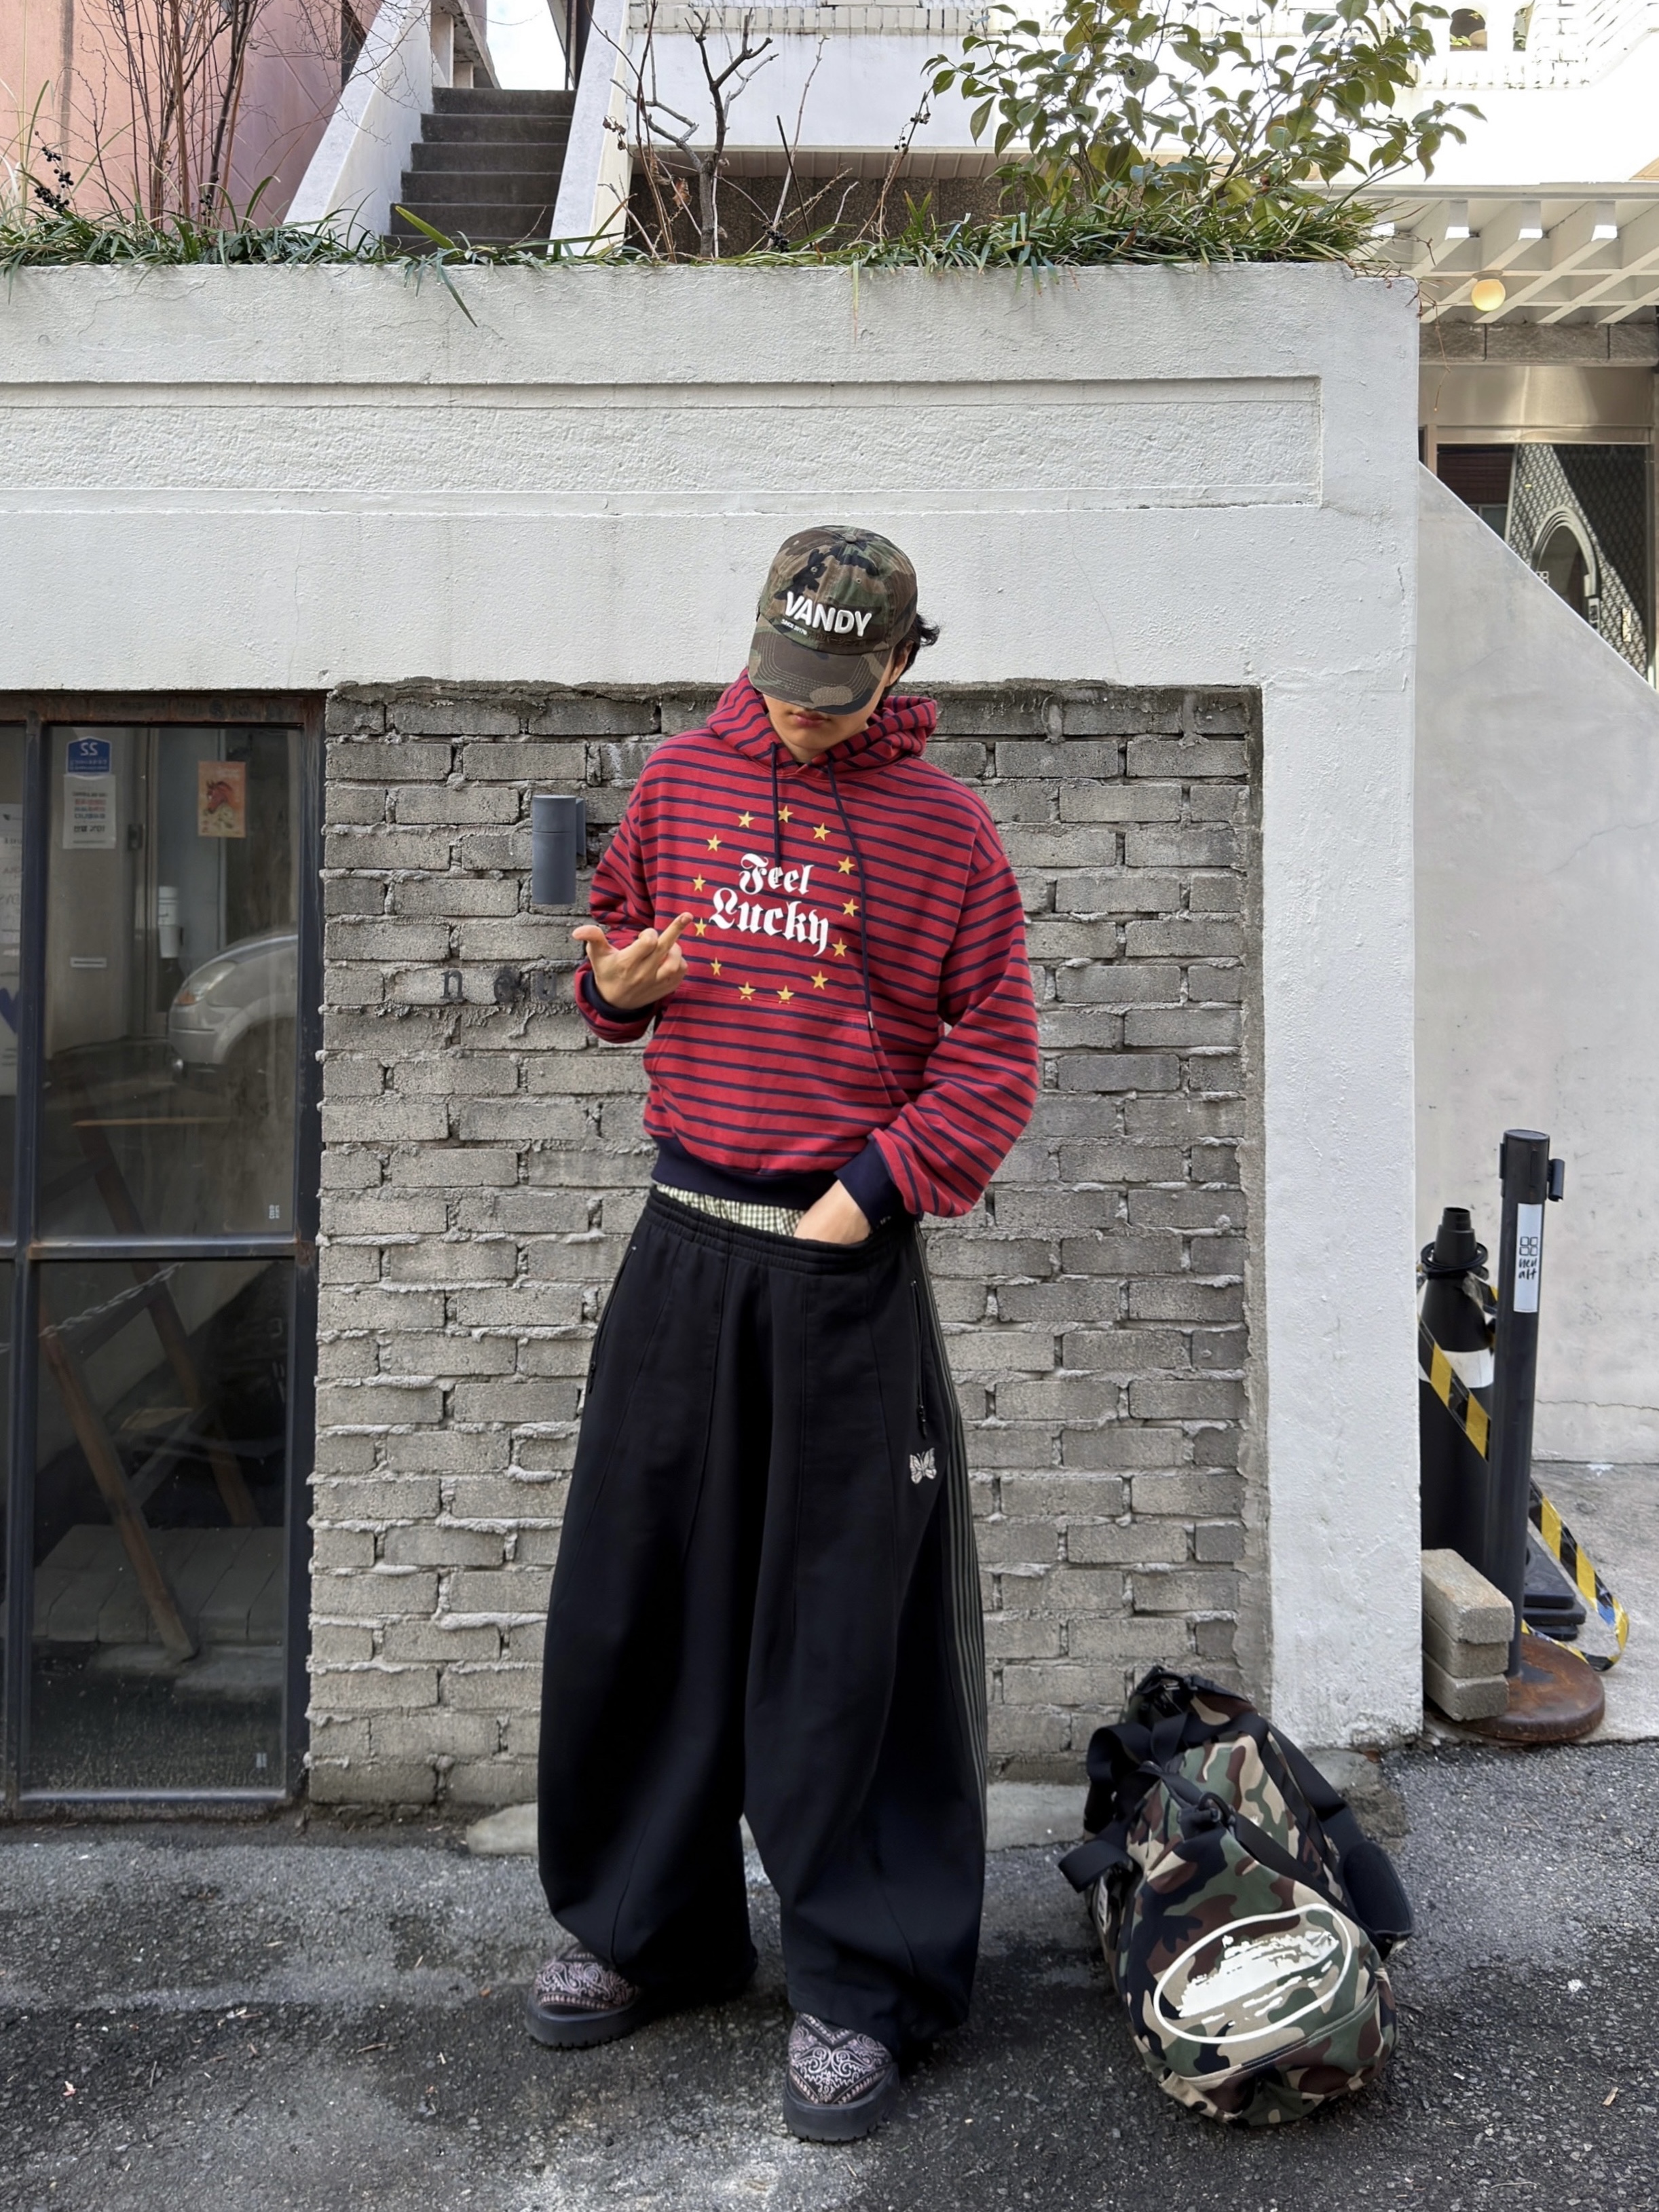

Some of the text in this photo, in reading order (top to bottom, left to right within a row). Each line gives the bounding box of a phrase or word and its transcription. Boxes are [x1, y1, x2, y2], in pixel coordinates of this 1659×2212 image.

[785, 591, 872, 637] VANDY
[739, 853, 814, 895] Feel
[709, 887, 829, 957] Lucky
